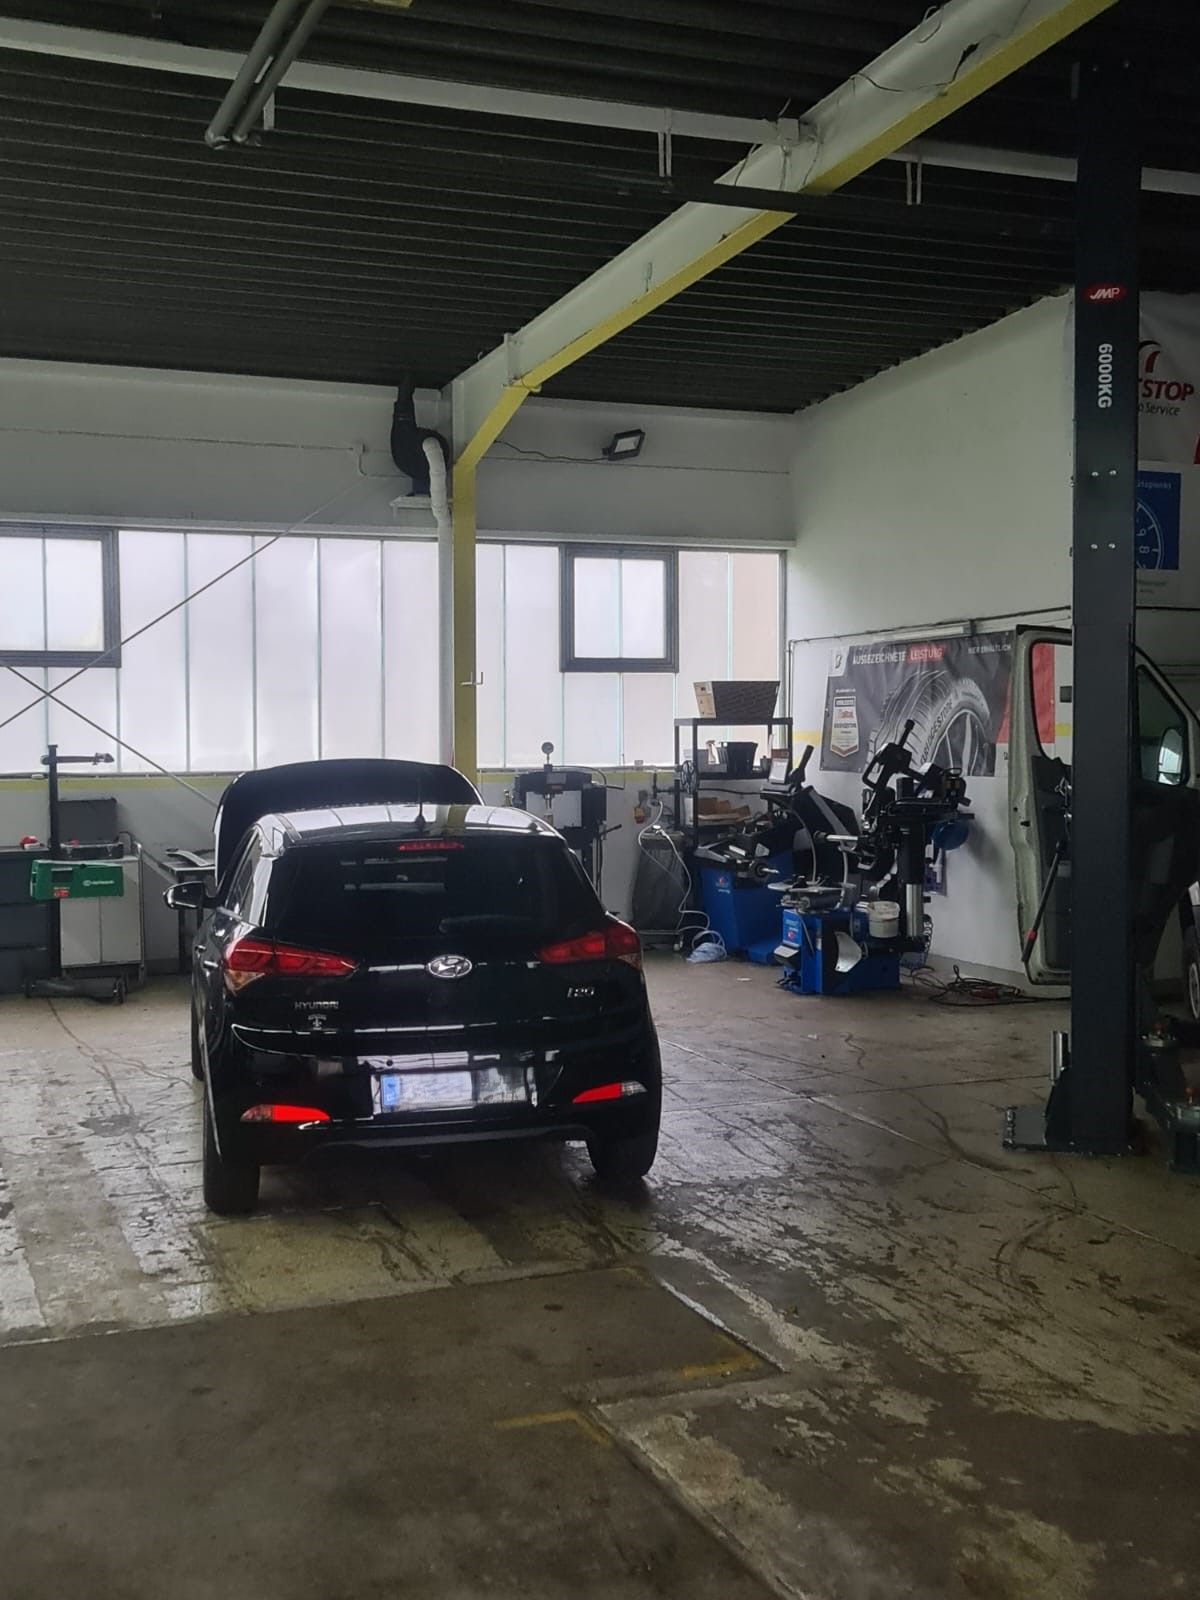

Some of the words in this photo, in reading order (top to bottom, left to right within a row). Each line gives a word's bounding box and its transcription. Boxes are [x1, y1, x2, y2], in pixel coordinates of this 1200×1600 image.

[1090, 287, 1120, 300] JMP
[1098, 343, 1113, 409] 6000KG
[1142, 379, 1195, 401] STOP
[1146, 402, 1181, 416] Service
[910, 648, 943, 661] LEISTUNG
[294, 1001, 339, 1009] HYUNDAI
